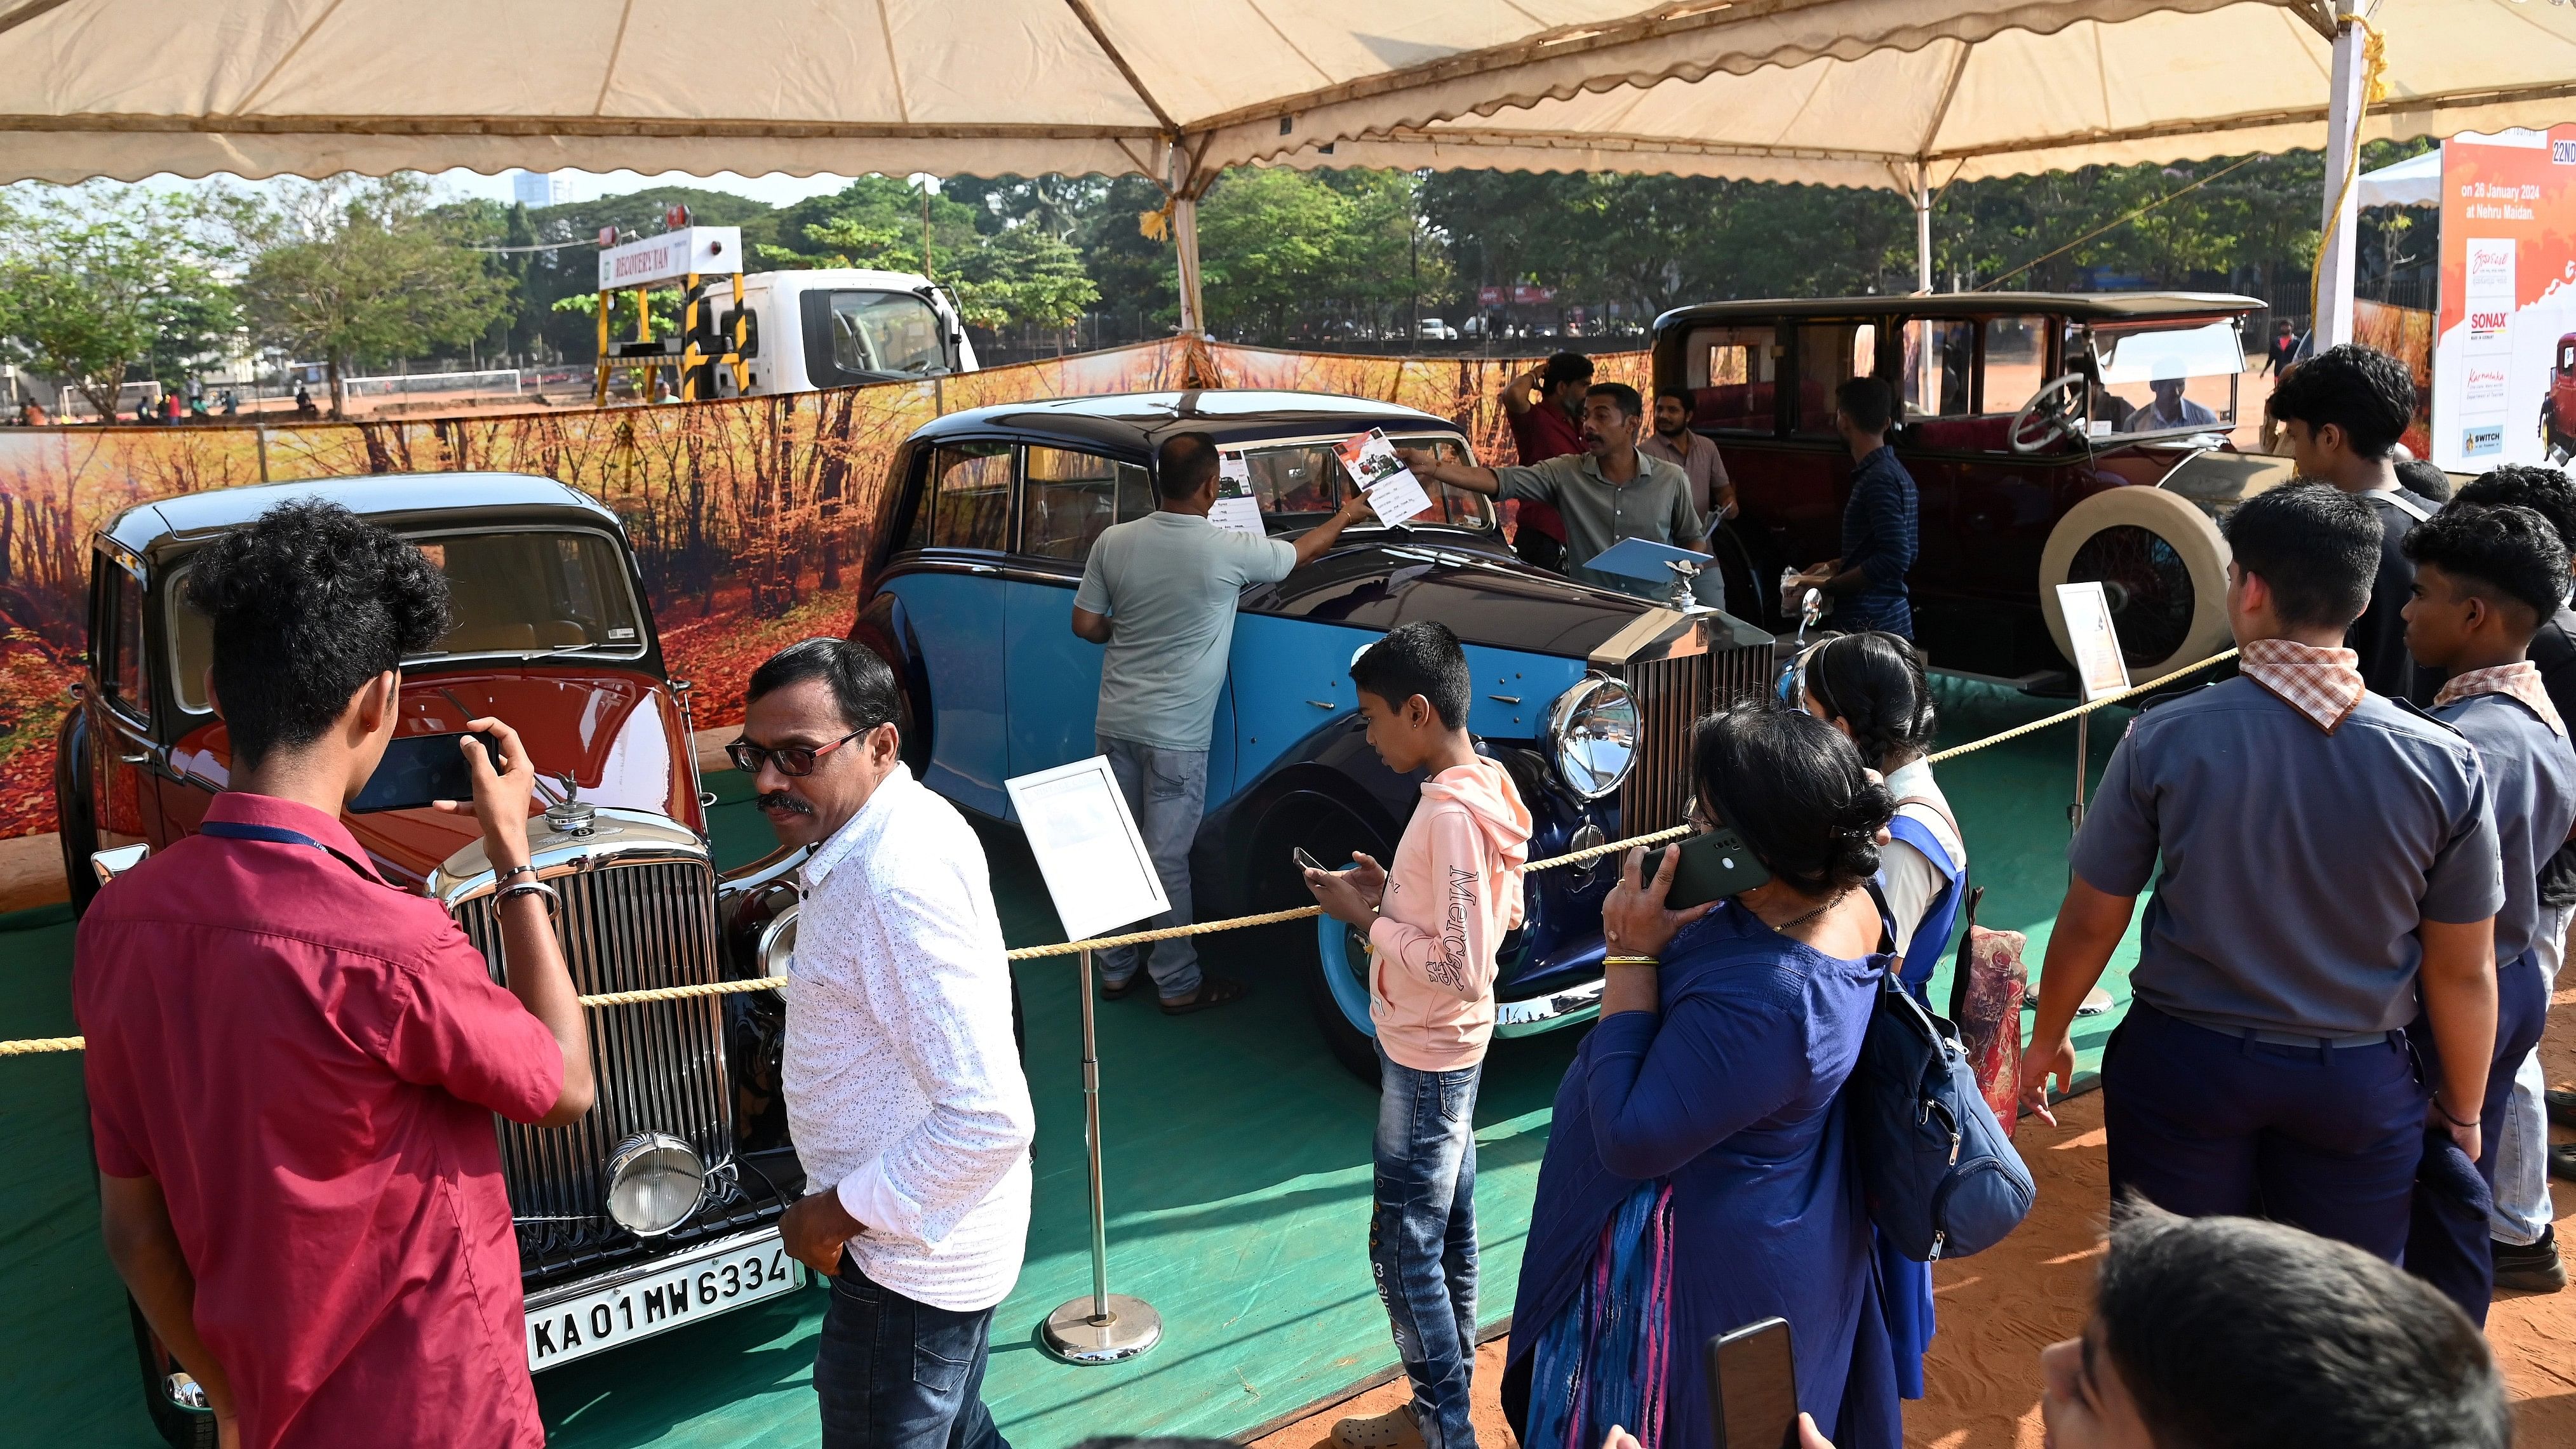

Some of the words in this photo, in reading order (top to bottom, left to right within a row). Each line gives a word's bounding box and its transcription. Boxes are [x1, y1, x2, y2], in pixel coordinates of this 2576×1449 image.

[2461, 185, 2472, 197] on
[2474, 182, 2485, 197] 26
[2486, 183, 2520, 203] January
[2520, 184, 2540, 200] 2024
[2465, 204, 2475, 219] at
[2476, 203, 2502, 219] Nehru
[2504, 203, 2534, 220] Maidan.
[616, 251, 654, 277] RECOVERY
[654, 246, 669, 270] VAN
[2471, 312, 2506, 329] SONAX
[2467, 368, 2504, 388] Karnataka
[2475, 432, 2500, 443] SWITCH
[534, 1313, 582, 1358] KA
[591, 1295, 634, 1338] 01
[643, 1278, 688, 1324] MW
[698, 1248, 786, 1305] 6334
